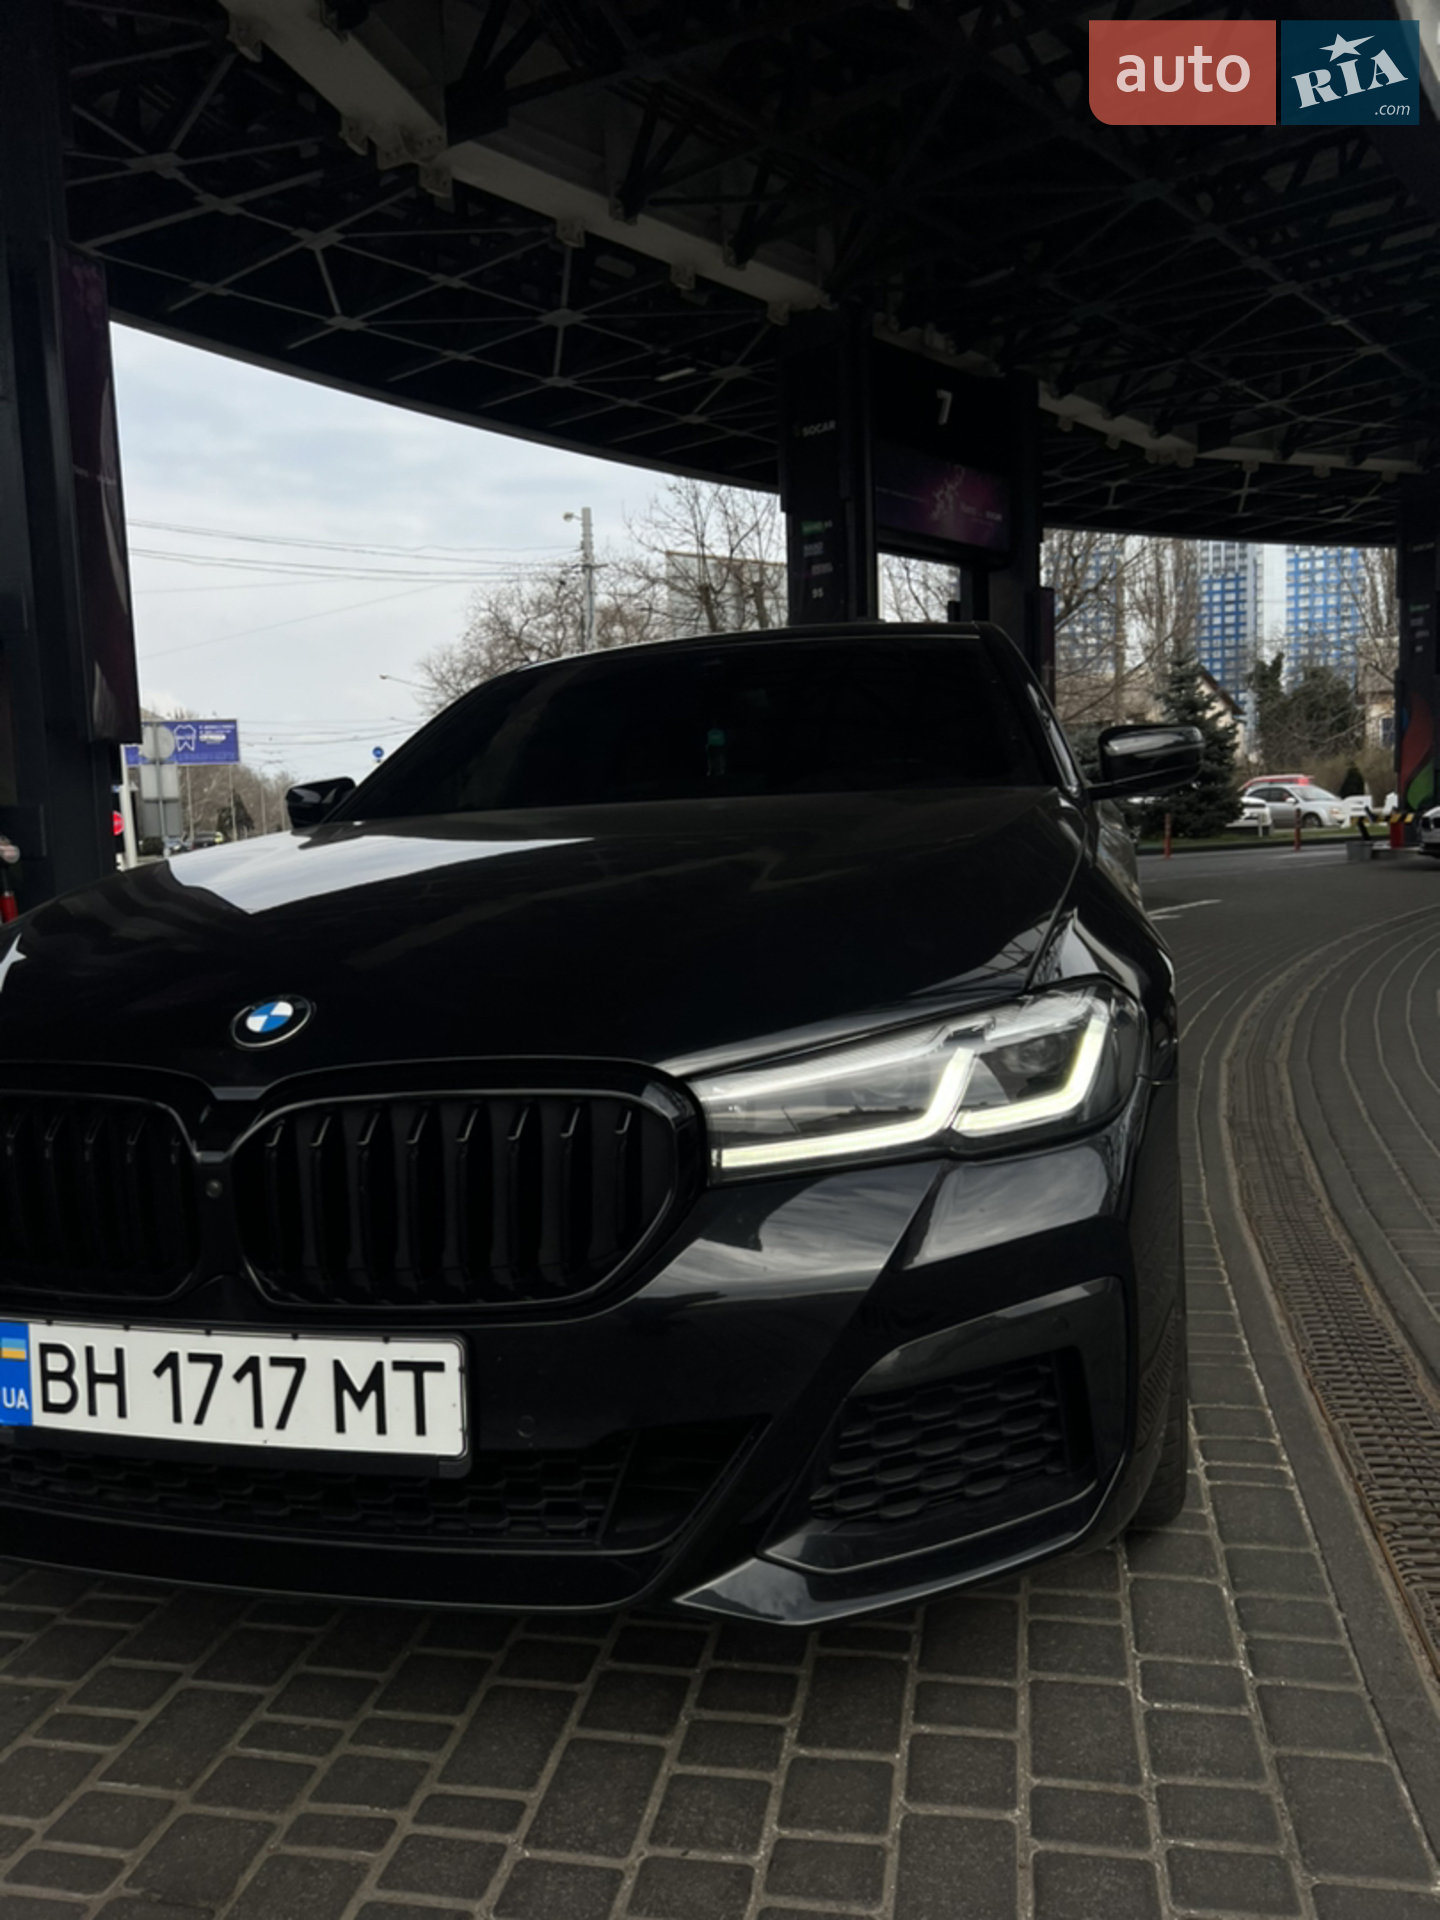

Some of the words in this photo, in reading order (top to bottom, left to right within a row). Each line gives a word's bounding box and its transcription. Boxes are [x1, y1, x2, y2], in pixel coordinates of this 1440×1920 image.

[936, 389, 953, 425] 7
[802, 420, 836, 437] SOCAR
[2, 1387, 30, 1411] UA
[39, 1342, 126, 1418] BH
[153, 1350, 306, 1430] 1717
[333, 1359, 445, 1436] MT
